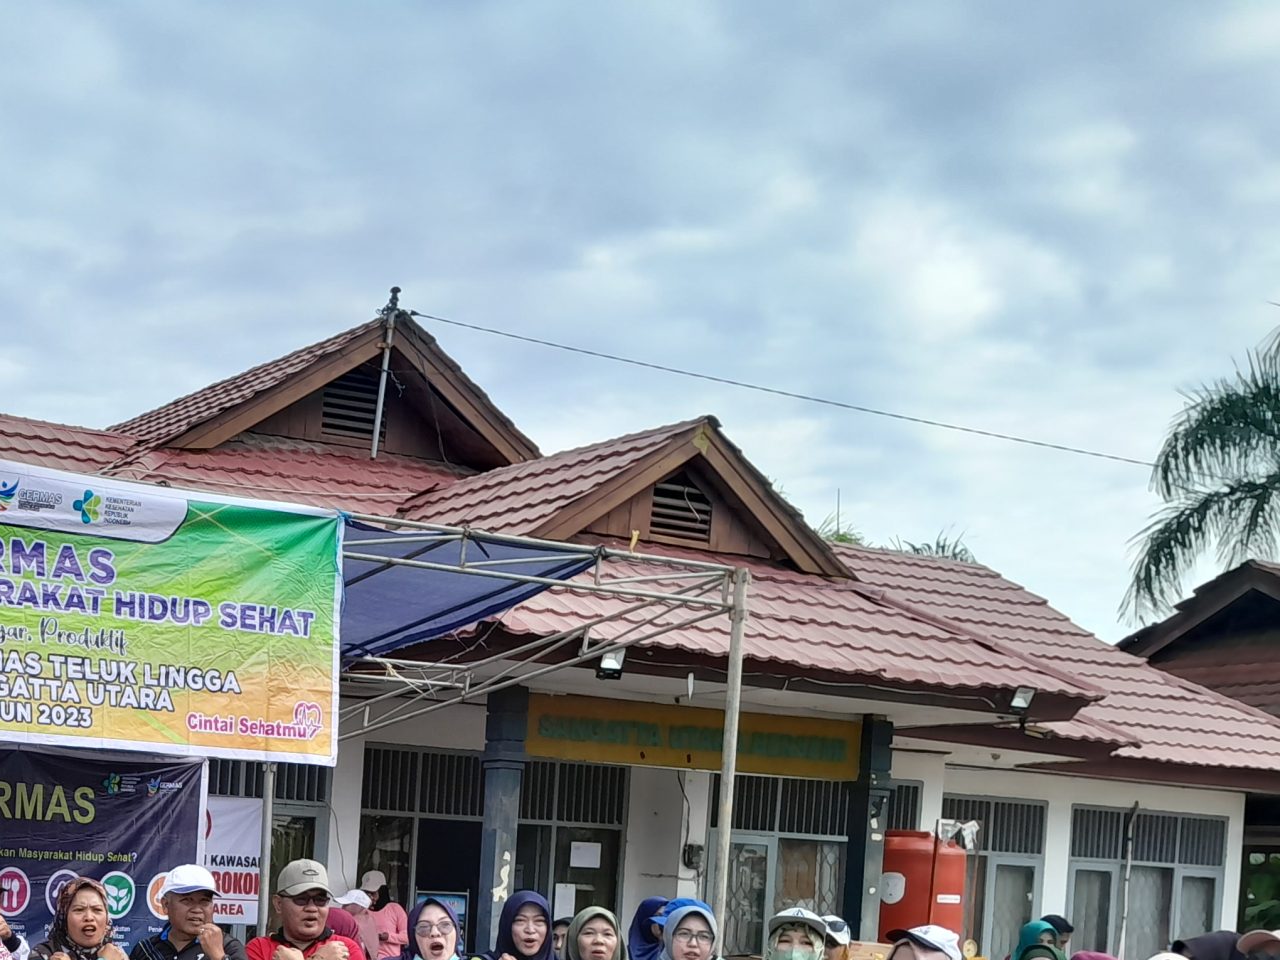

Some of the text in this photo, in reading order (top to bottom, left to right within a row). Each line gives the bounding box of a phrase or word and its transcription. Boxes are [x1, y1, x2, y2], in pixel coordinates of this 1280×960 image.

[18, 488, 62, 505] GERMAS
[115, 591, 211, 624] HIDUP
[219, 603, 315, 637] SEHAT
[40, 617, 128, 656] Produktif
[49, 654, 137, 685] TELUK
[143, 664, 242, 694] LINGGA
[87, 680, 174, 711] UTARA
[38, 704, 92, 727] 2023
[187, 713, 307, 738] Cintai Sehatmu
[18, 847, 73, 862] Masyarakat
[75, 850, 105, 864] Hidup
[213, 904, 244, 916] AREA
